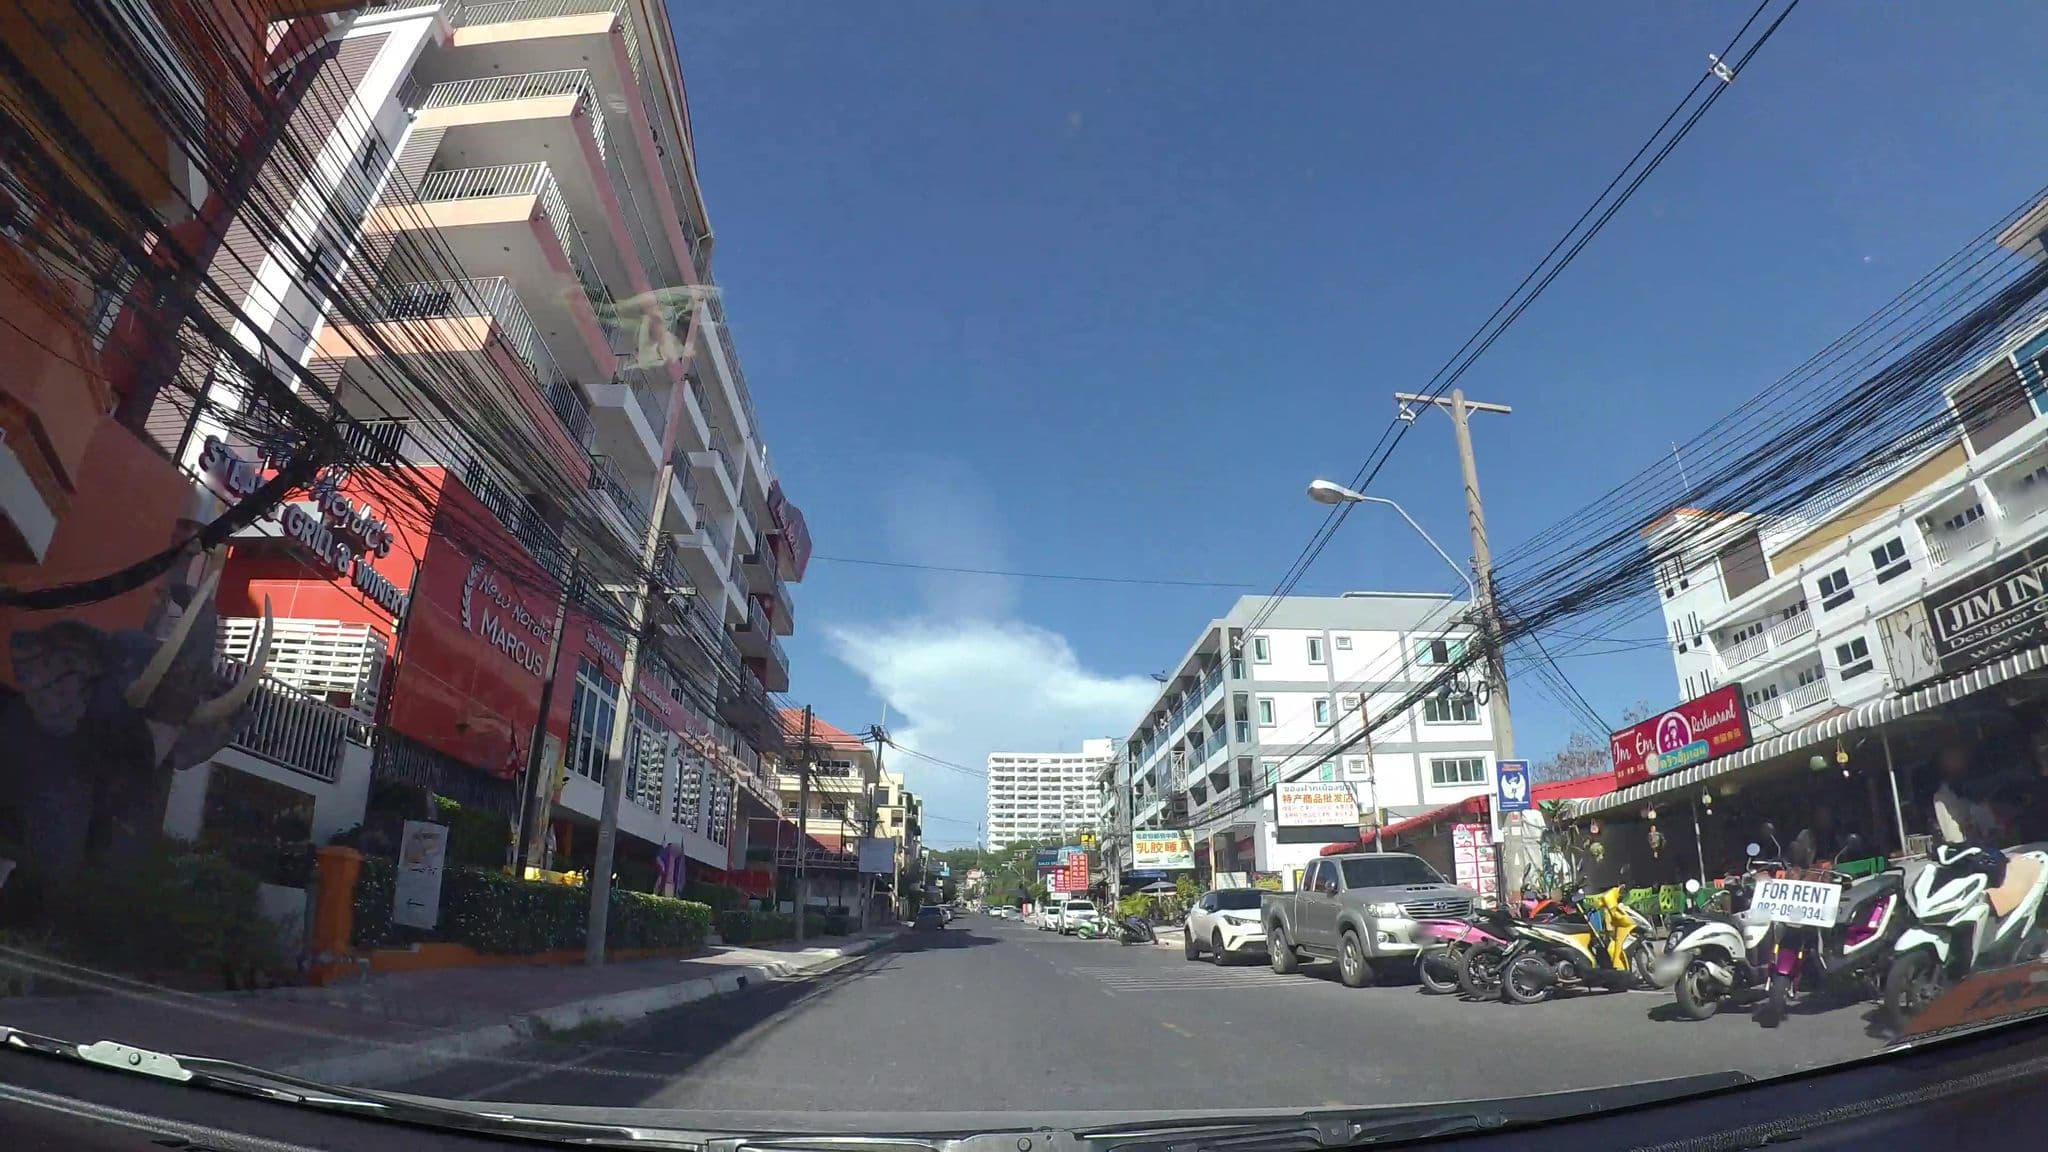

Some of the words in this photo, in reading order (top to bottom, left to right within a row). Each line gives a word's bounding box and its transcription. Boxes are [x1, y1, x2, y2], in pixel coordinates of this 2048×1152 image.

[1950, 587, 2003, 631] JIM
[1950, 608, 2031, 649] Designer
[480, 607, 544, 676] MARCUS
[1762, 882, 1789, 900] FOR
[1792, 884, 1831, 904] RENT
